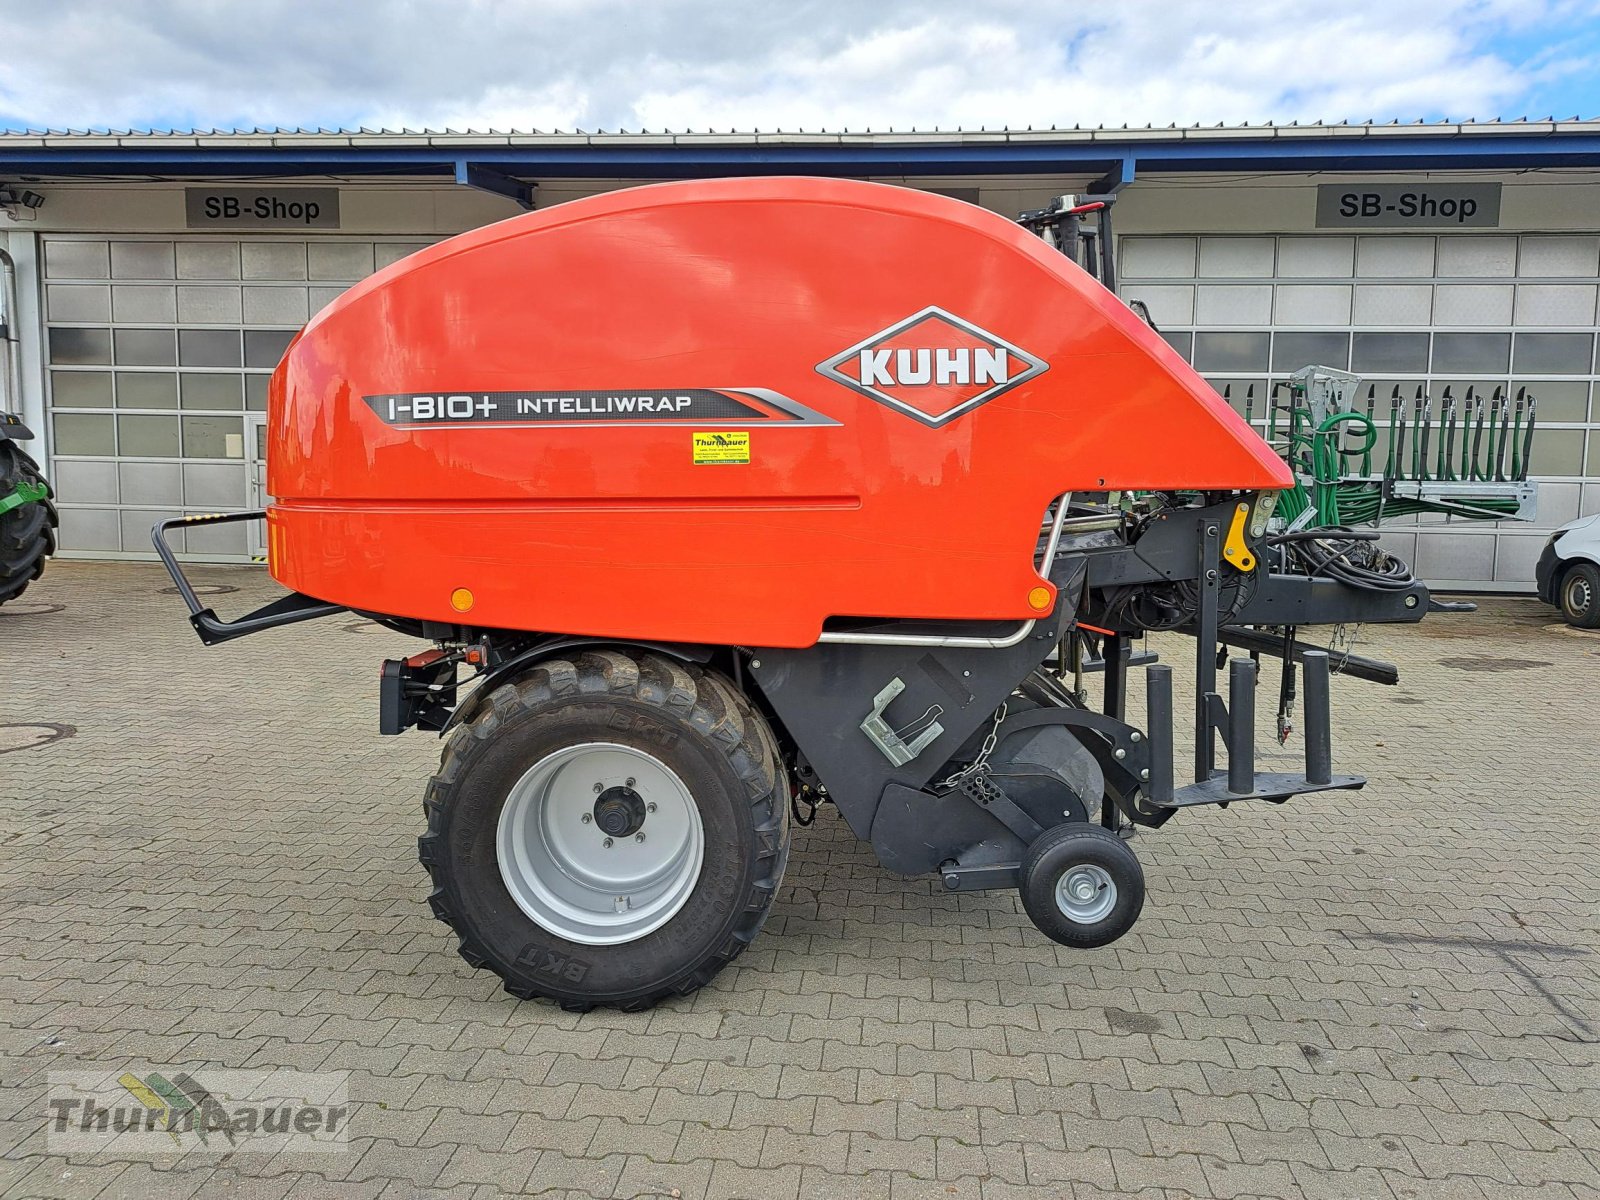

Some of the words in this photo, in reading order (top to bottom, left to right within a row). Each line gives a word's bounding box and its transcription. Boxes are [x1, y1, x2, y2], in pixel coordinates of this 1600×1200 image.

[205, 197, 320, 224] SB-Shop
[1339, 193, 1477, 222] SB-Shop
[860, 348, 1008, 385] KUHN
[389, 395, 498, 420] I-BIO+
[517, 396, 692, 414] INTELLIWRAP
[516, 948, 588, 983] BKT
